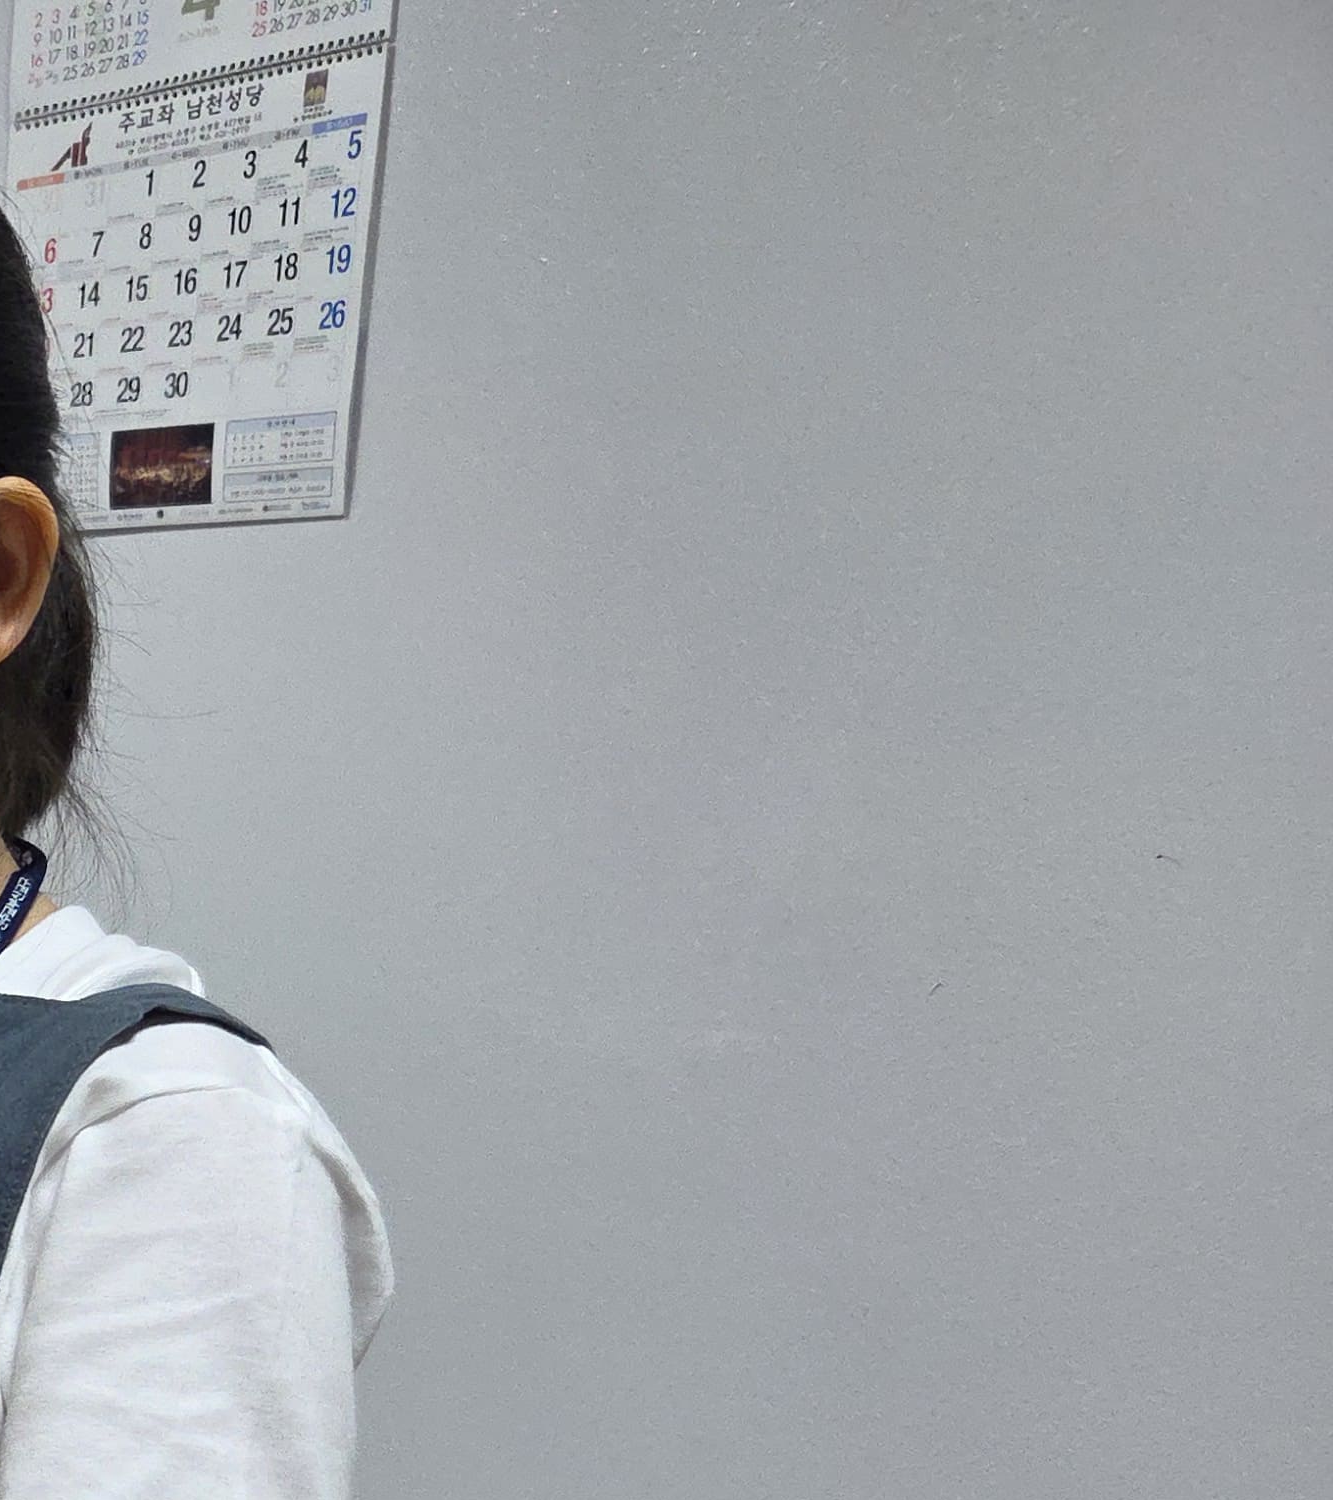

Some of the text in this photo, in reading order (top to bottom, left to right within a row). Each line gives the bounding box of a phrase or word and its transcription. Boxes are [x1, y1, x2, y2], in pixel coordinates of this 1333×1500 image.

[35, 13, 43, 28] 2
[52, 9, 60, 24] 3
[69, 5, 78, 19] 4
[87, 2, 96, 17] 5
[252, 22, 267, 38] 25
[269, 18, 284, 34] 26
[286, 13, 303, 29] 27
[305, 10, 321, 25] 28
[323, 6, 339, 21] 29
[341, 2, 357, 18] 30
[254, 1, 268, 17] 18
[34, 10, 149, 47] 9 10 11 12 13 14 15
[31, 29, 149, 69] 16 17 18 19 20 21 22
[63, 66, 78, 81] 25
[81, 62, 96, 77] 26
[98, 58, 113, 74] 27
[116, 54, 130, 70] 28
[133, 50, 147, 66] 29
[118, 102, 175, 134] 주교좌
[187, 83, 265, 121] 남천성당
[146, 169, 154, 197] 1
[192, 160, 206, 188] 2
[243, 150, 257, 179] 3
[294, 139, 308, 168] 4
[347, 129, 362, 159] 5
[44, 187, 357, 263] 6 7 8 9 10 11 12
[40, 245, 351, 313] 3 14 15 16 17 18 19
[73, 300, 346, 358] 21 22 23 24 25 26
[70, 381, 93, 407] 28
[116, 376, 141, 403] 29
[164, 371, 188, 399] 30
